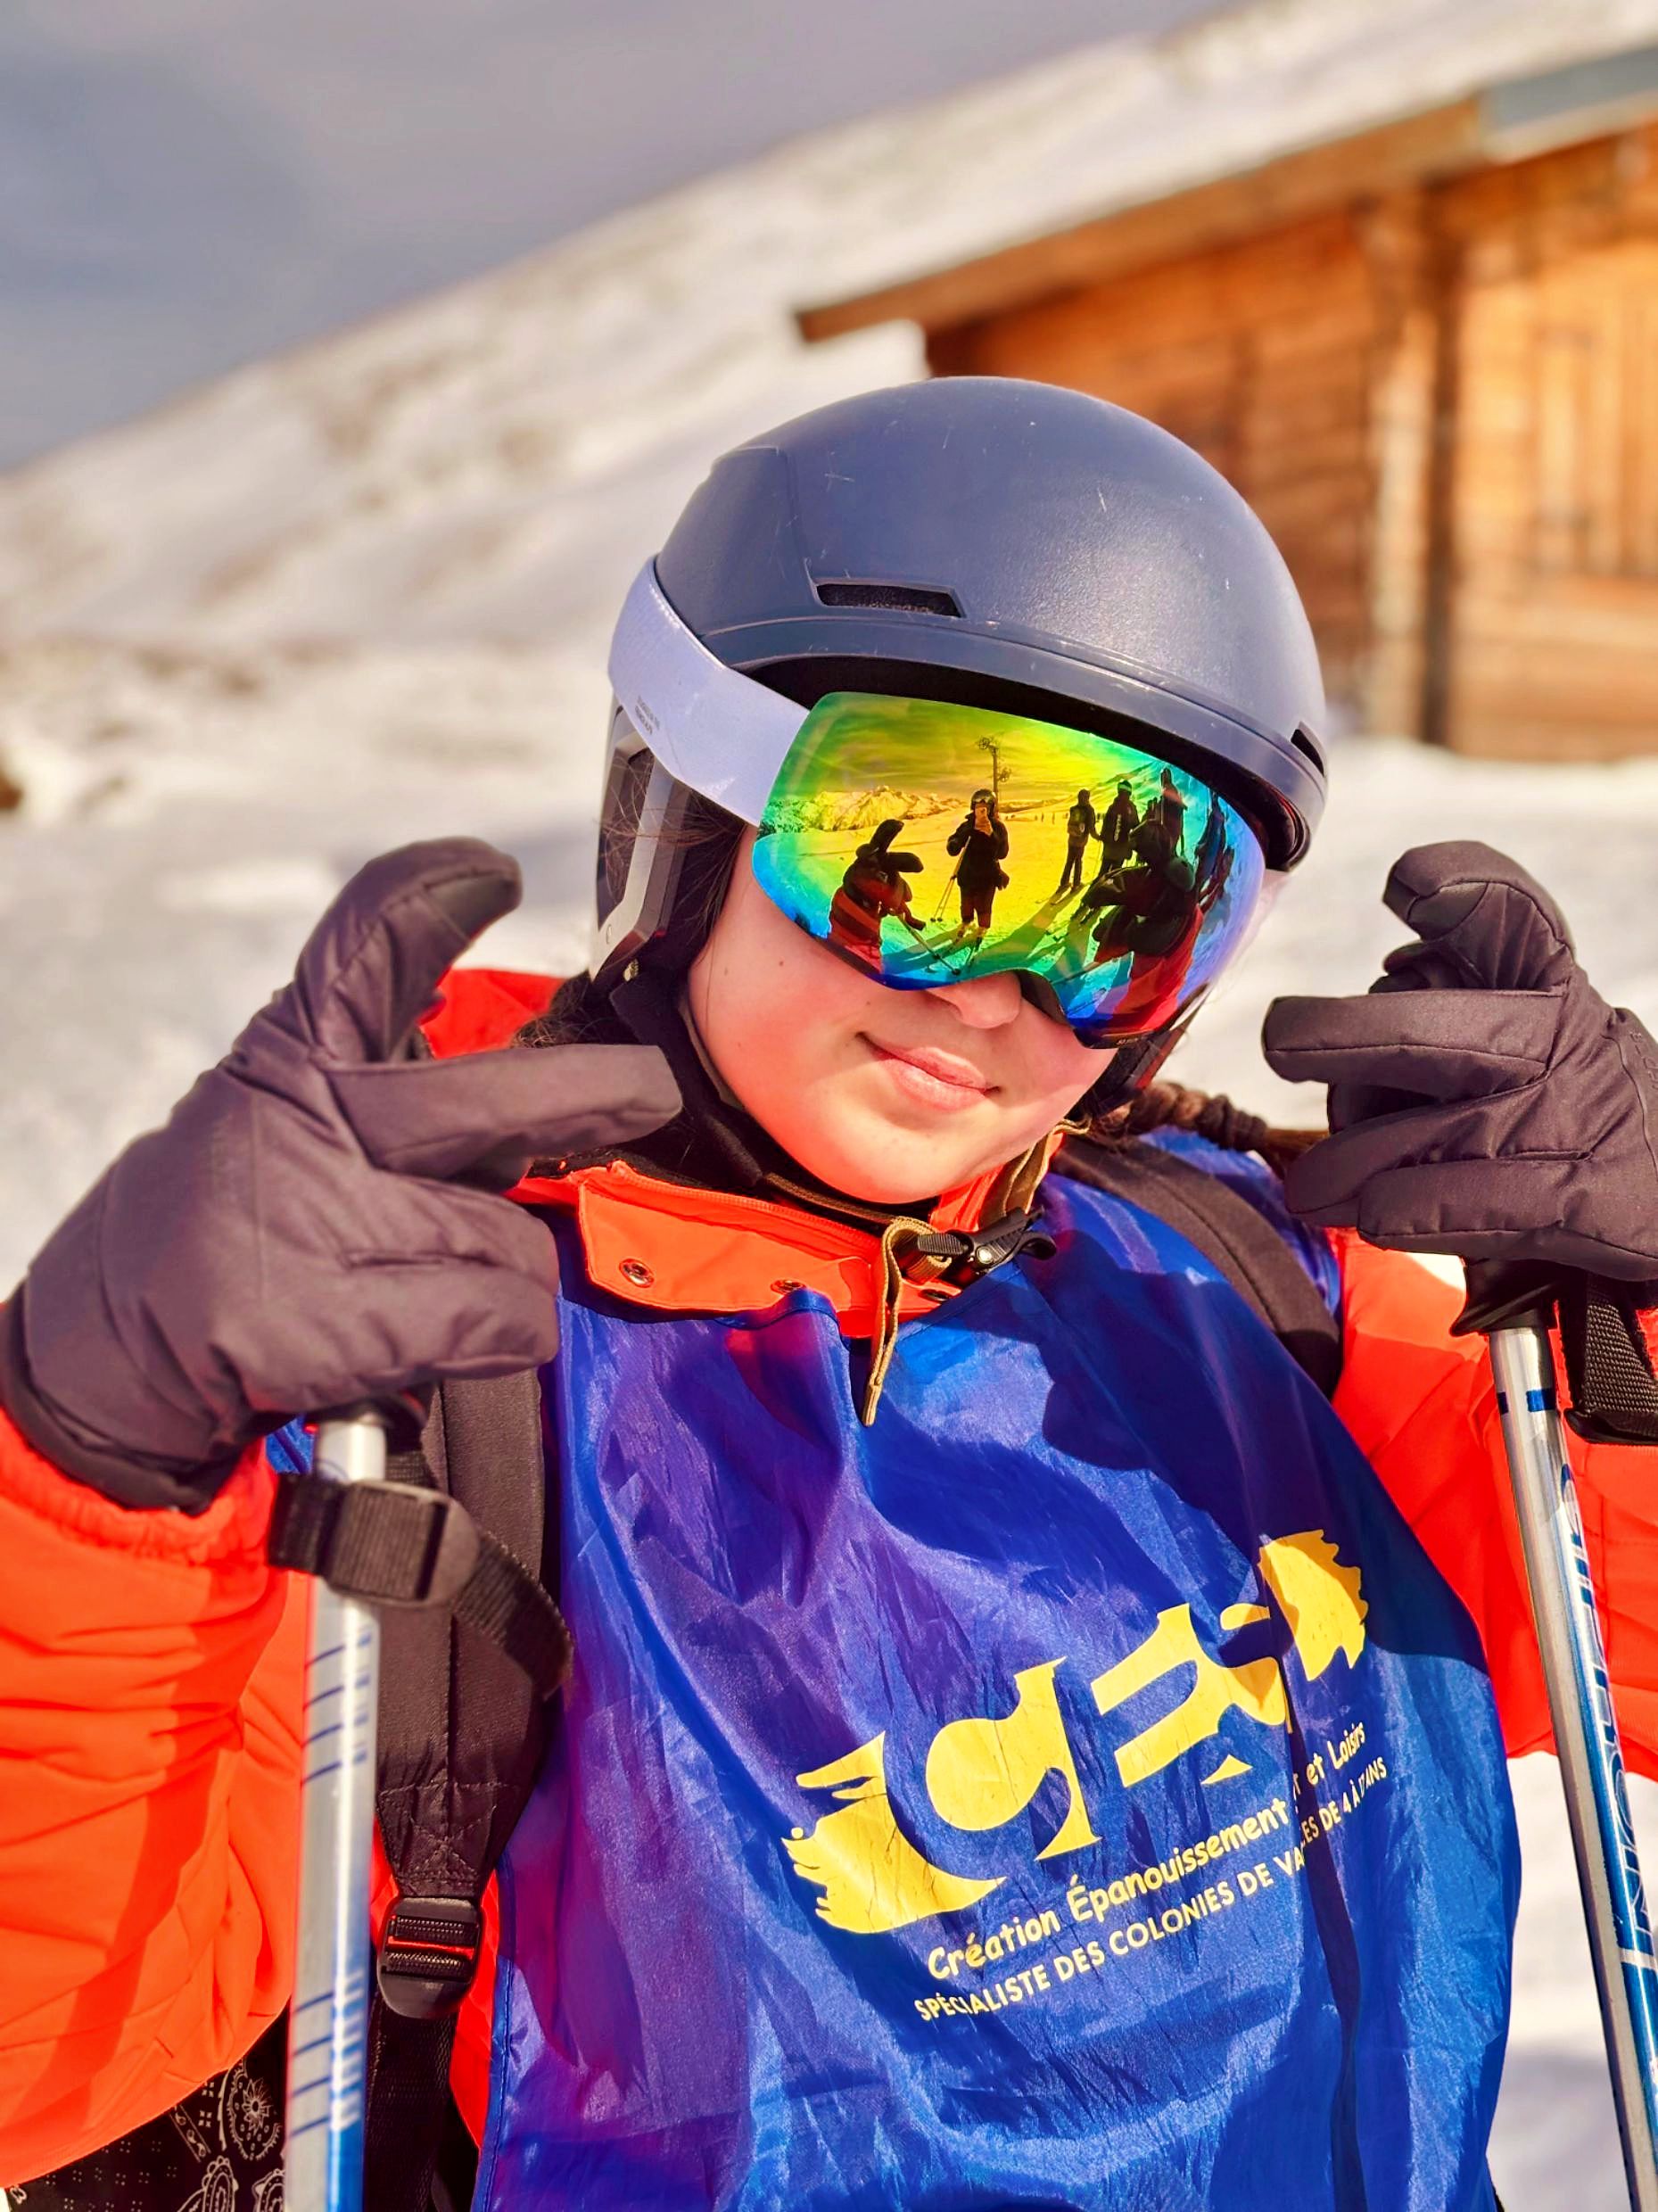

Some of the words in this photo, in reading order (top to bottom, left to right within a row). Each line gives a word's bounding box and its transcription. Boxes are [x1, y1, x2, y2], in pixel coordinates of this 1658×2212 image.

[914, 1965, 1052, 2021] SPÉCIALISTE
[1053, 1941, 1105, 1981] DES
[1109, 1881, 1235, 1955] COLONIES
[1237, 1863, 1274, 1896] DE
[1318, 1800, 1341, 1831] DE
[1342, 1791, 1352, 1813] 4
[928, 1911, 1061, 1979] Création
[1066, 1797, 1290, 1922] Épanouissement
[1306, 1753, 1325, 1785] et
[1327, 1721, 1365, 1770] Loisirs
